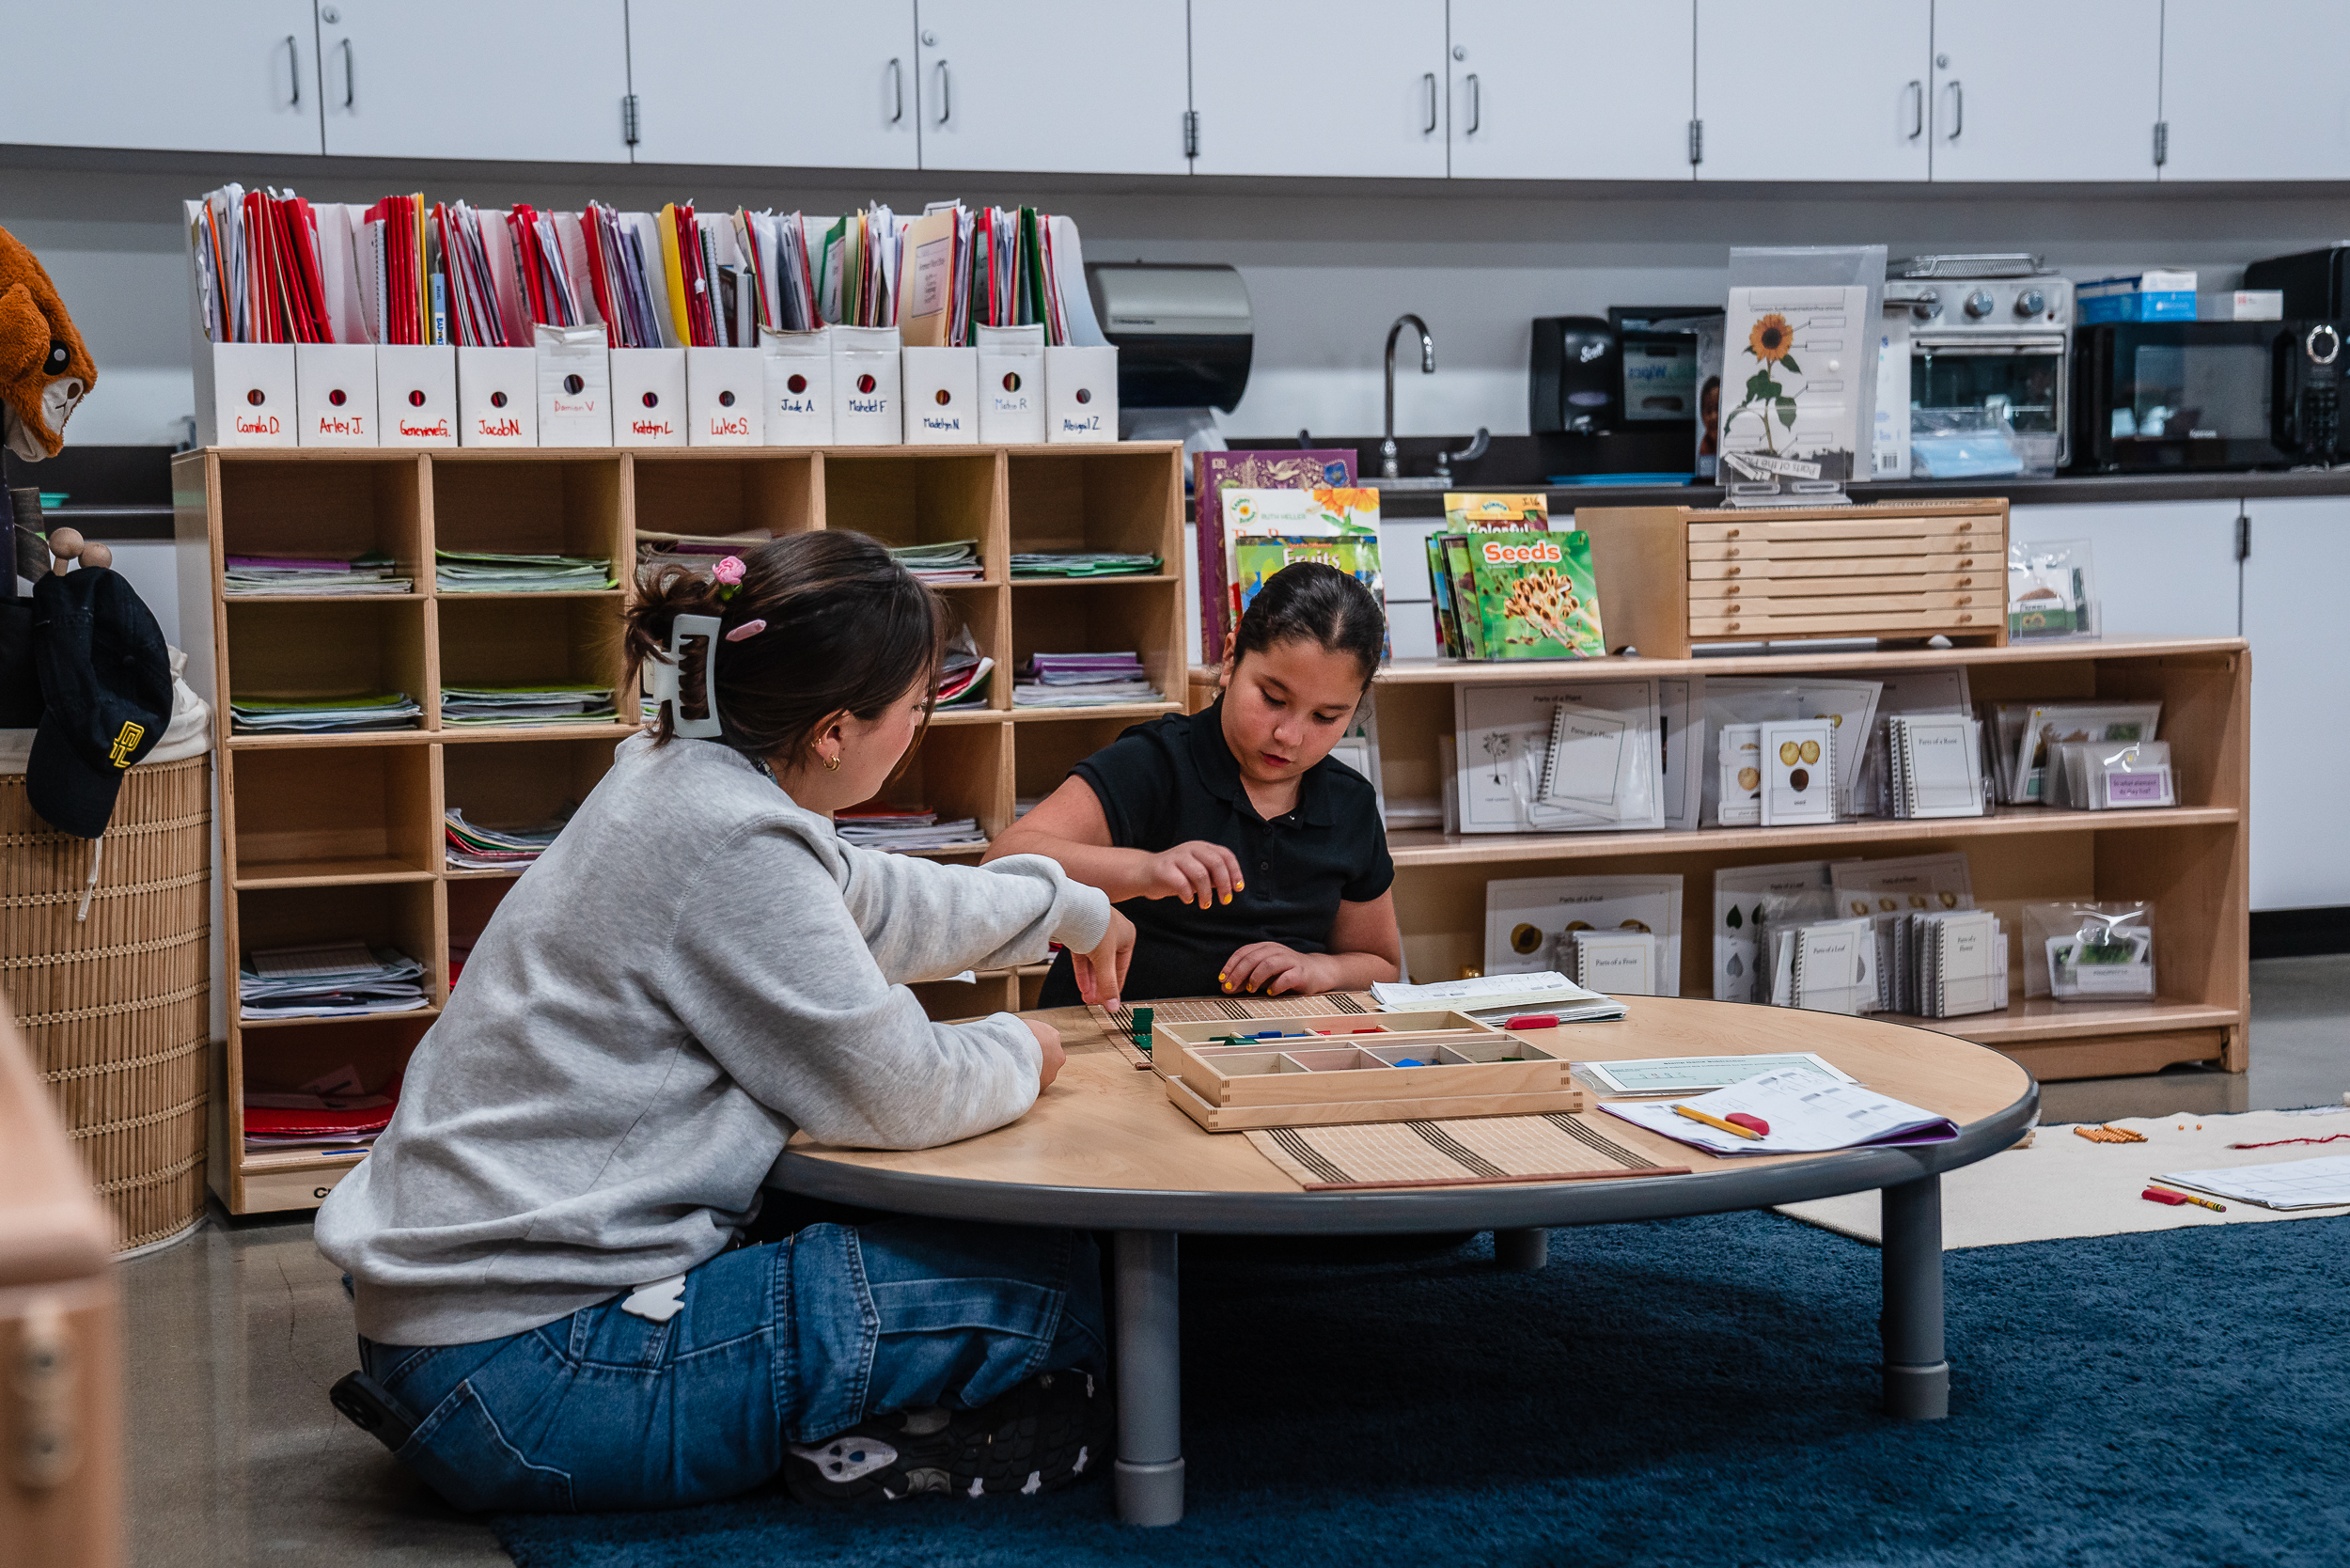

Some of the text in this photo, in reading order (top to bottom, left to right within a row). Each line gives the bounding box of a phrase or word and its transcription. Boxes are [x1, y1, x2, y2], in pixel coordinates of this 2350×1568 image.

[1580, 342, 1605, 363] Scott
[781, 399, 815, 413] Jade A
[879, 400, 887, 413] F
[1019, 398, 1027, 410] R
[237, 416, 268, 433] Camila
[320, 416, 364, 435] Arley J.
[478, 418, 509, 436] Jacob
[665, 421, 674, 434] L
[711, 416, 750, 435] Luke S.
[1092, 416, 1101, 431] Z
[1283, 548, 1340, 570] Fruits
[1483, 541, 1561, 562] Seeds
